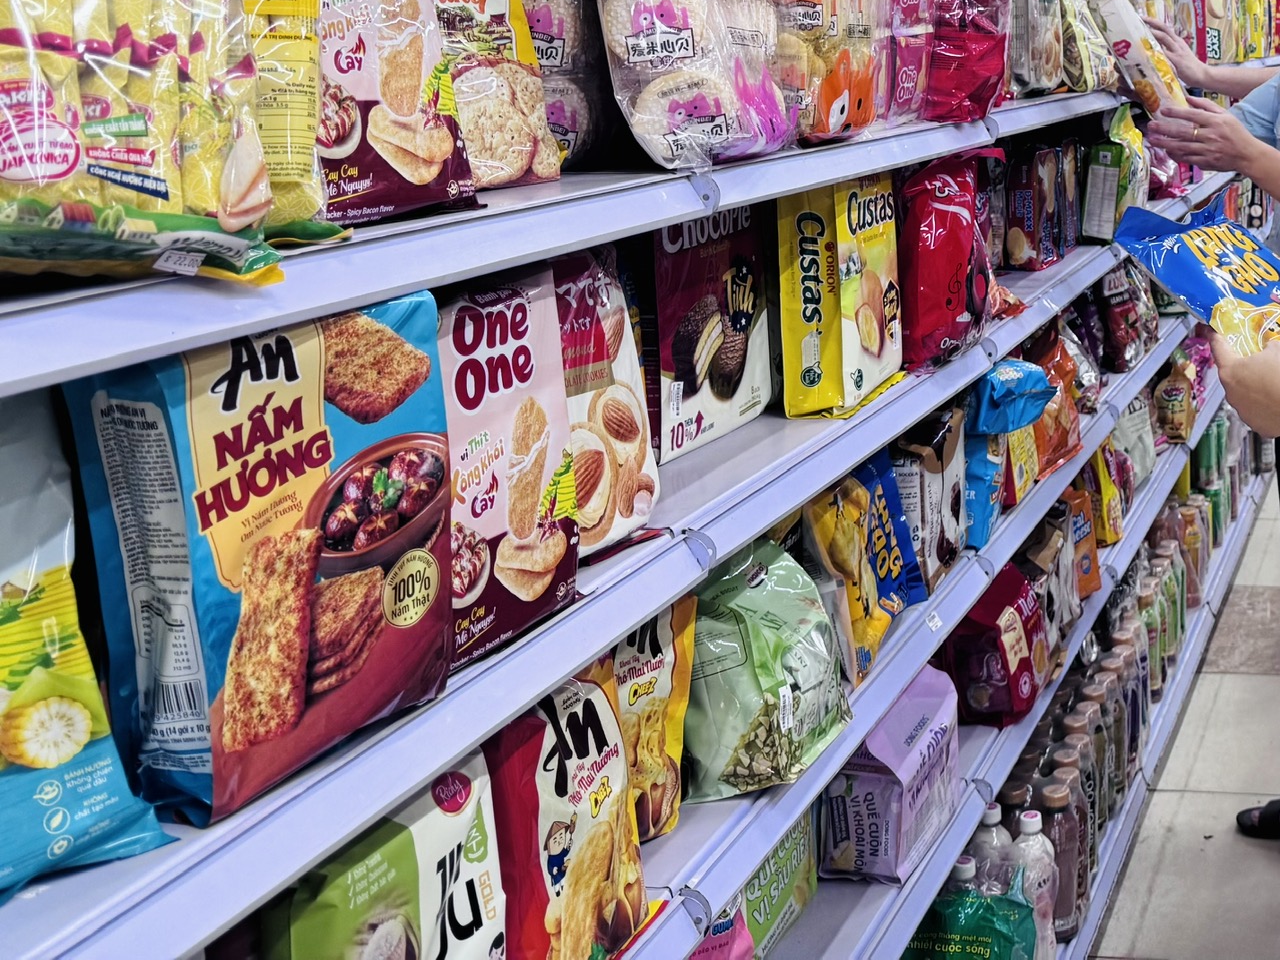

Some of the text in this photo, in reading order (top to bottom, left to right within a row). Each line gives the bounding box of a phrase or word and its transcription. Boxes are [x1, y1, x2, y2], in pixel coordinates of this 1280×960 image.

[899, 67, 917, 86] One
[897, 85, 914, 103] One
[341, 163, 359, 180] Cay
[347, 207, 362, 219] Spicy
[362, 205, 379, 216] Bacon
[847, 190, 894, 238] Custas
[796, 210, 827, 325] Custas
[826, 252, 836, 296] ORION
[453, 301, 528, 358] One
[210, 334, 299, 412] An
[454, 342, 533, 411] One
[585, 368, 609, 383] COOKIES
[213, 391, 304, 470] NẤM
[460, 430, 490, 461] vị Thịt
[670, 422, 694, 450] 10 %
[195, 429, 331, 532] HƯƠNG
[450, 439, 505, 506] Xông khói
[241, 515, 252, 529] Vị
[269, 490, 297, 512] Hương
[273, 499, 304, 521] Tương
[470, 482, 498, 520] Cay
[417, 554, 434, 569] HƯƠNG
[391, 565, 431, 608] 100%
[391, 591, 431, 622] Nấm Thật
[455, 605, 485, 634] Cay Cay
[455, 631, 469, 649] Mê
[485, 636, 500, 652] Bacon
[628, 664, 645, 682] Mai
[628, 677, 657, 707] CHEEZ
[163, 711, 201, 721] 425840
[66, 775, 92, 789] Không
[436, 772, 465, 806] Richy
[589, 776, 612, 819] CHEEZ
[851, 794, 864, 848] VỊ KHOAI
[863, 791, 880, 858] QUẾ CUỘN
[478, 869, 497, 921] GOLD
[935, 942, 991, 959] cuộc sống
